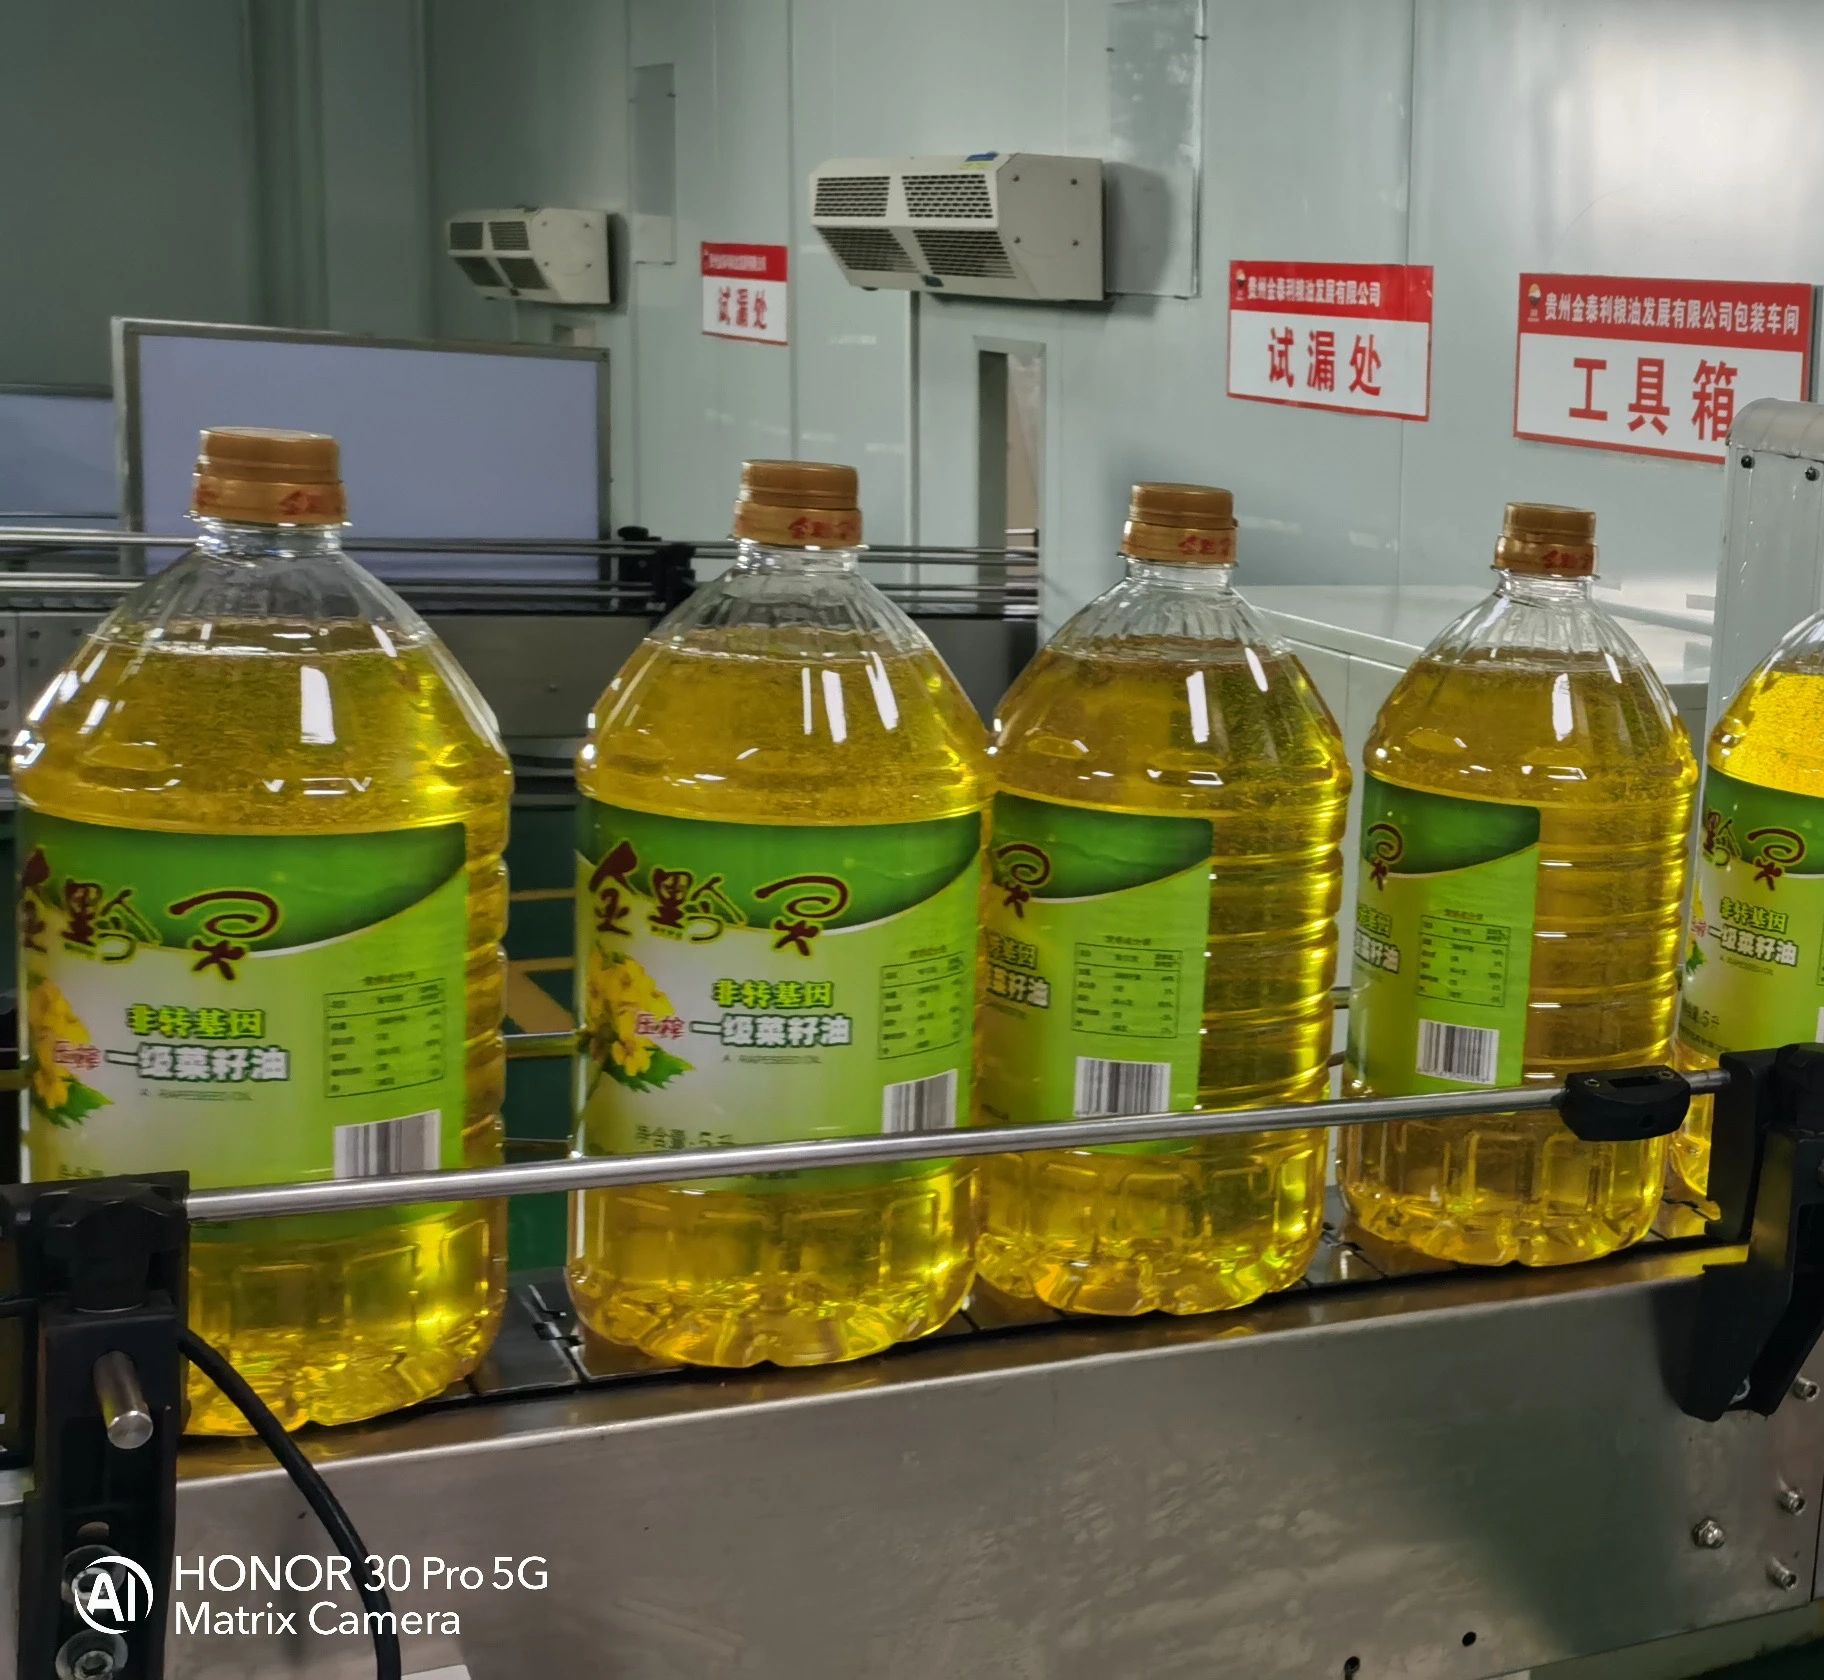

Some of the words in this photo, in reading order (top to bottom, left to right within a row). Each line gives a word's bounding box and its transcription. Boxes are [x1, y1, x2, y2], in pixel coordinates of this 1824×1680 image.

[1247, 276, 1381, 308] 贵州金泰利粮油发展有限公司
[1545, 292, 1800, 336] 贵州金泰利粮油发展有限公司包装车间
[1267, 328, 1382, 397] 试漏处
[1568, 357, 1738, 442] 工具箱
[1708, 924, 1799, 967] 一级菜籽油
[712, 978, 835, 1009] 非转基因
[126, 1002, 266, 1039] 非转基因
[634, 1013, 685, 1039] 压榨
[689, 1012, 853, 1048] 一级菜籽油
[104, 1040, 291, 1082] 一级菜籽油
